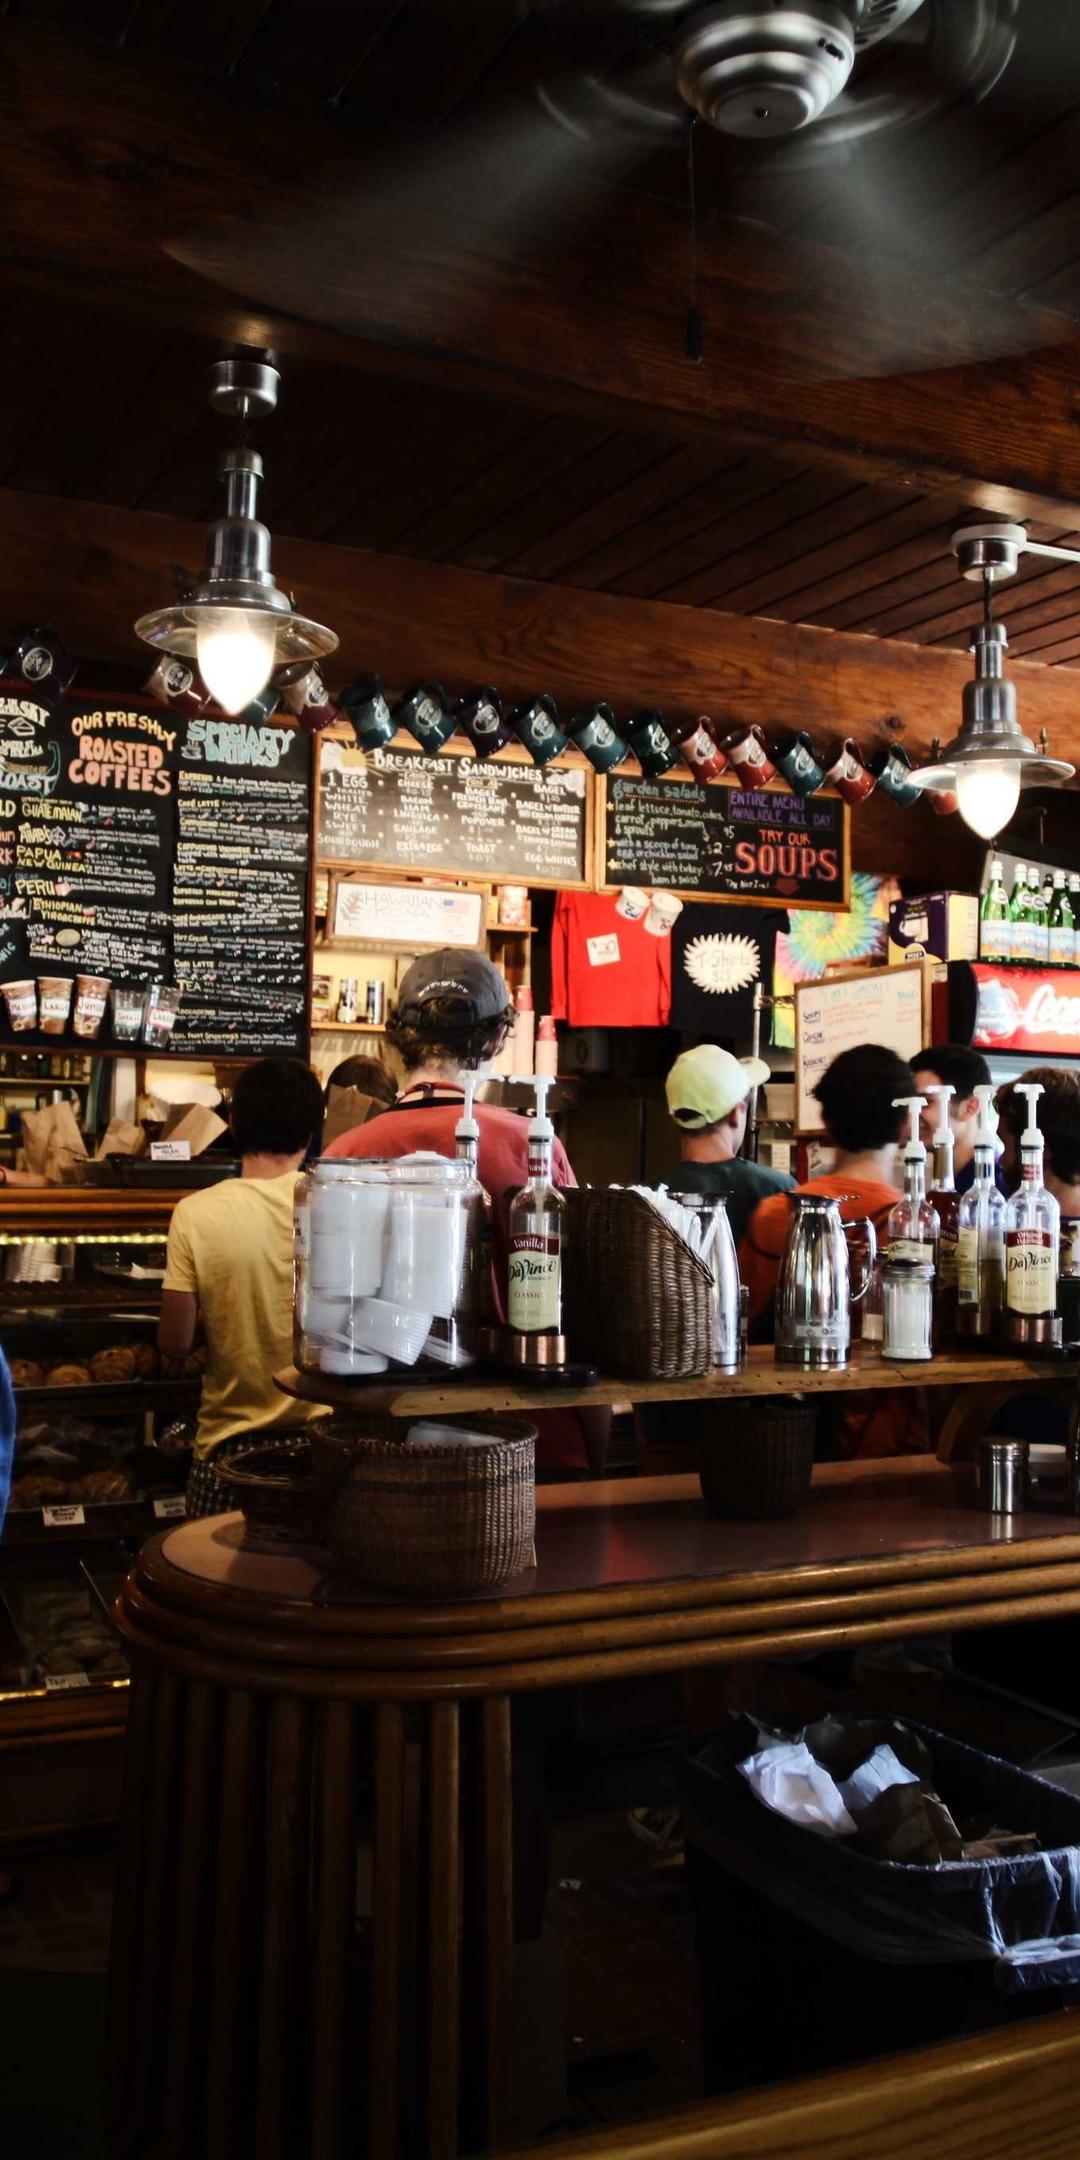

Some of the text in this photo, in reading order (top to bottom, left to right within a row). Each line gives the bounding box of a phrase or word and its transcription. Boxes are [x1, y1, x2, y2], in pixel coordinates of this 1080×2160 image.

[71, 711, 102, 736] OUR
[105, 711, 176, 751] FRESHLY
[79, 735, 163, 769] ROASTED
[373, 748, 543, 782] BREAKFAST SANDWICHES
[68, 759, 172, 796] COFFEES
[327, 772, 368, 788] 1 EGG
[612, 779, 706, 803] garden salads
[324, 801, 367, 814] WHEAT
[730, 791, 805, 811] ENTIRE MENU
[333, 811, 357, 821] RYE
[789, 813, 808, 826] ALL
[813, 814, 833, 827] DAY
[759, 829, 811, 846] TRY OUR
[16, 845, 62, 861] PAPUA
[734, 842, 839, 881] SOUPS
[17, 857, 46, 868] NEW
[46, 859, 86, 873] GUINEA
[16, 879, 55, 896] PERU
[176, 979, 202, 992] TEA
[513, 1237, 545, 1250] Vanilla
[509, 1258, 557, 1283] DaVinci
[1008, 1252, 1052, 1272] DaVinci
